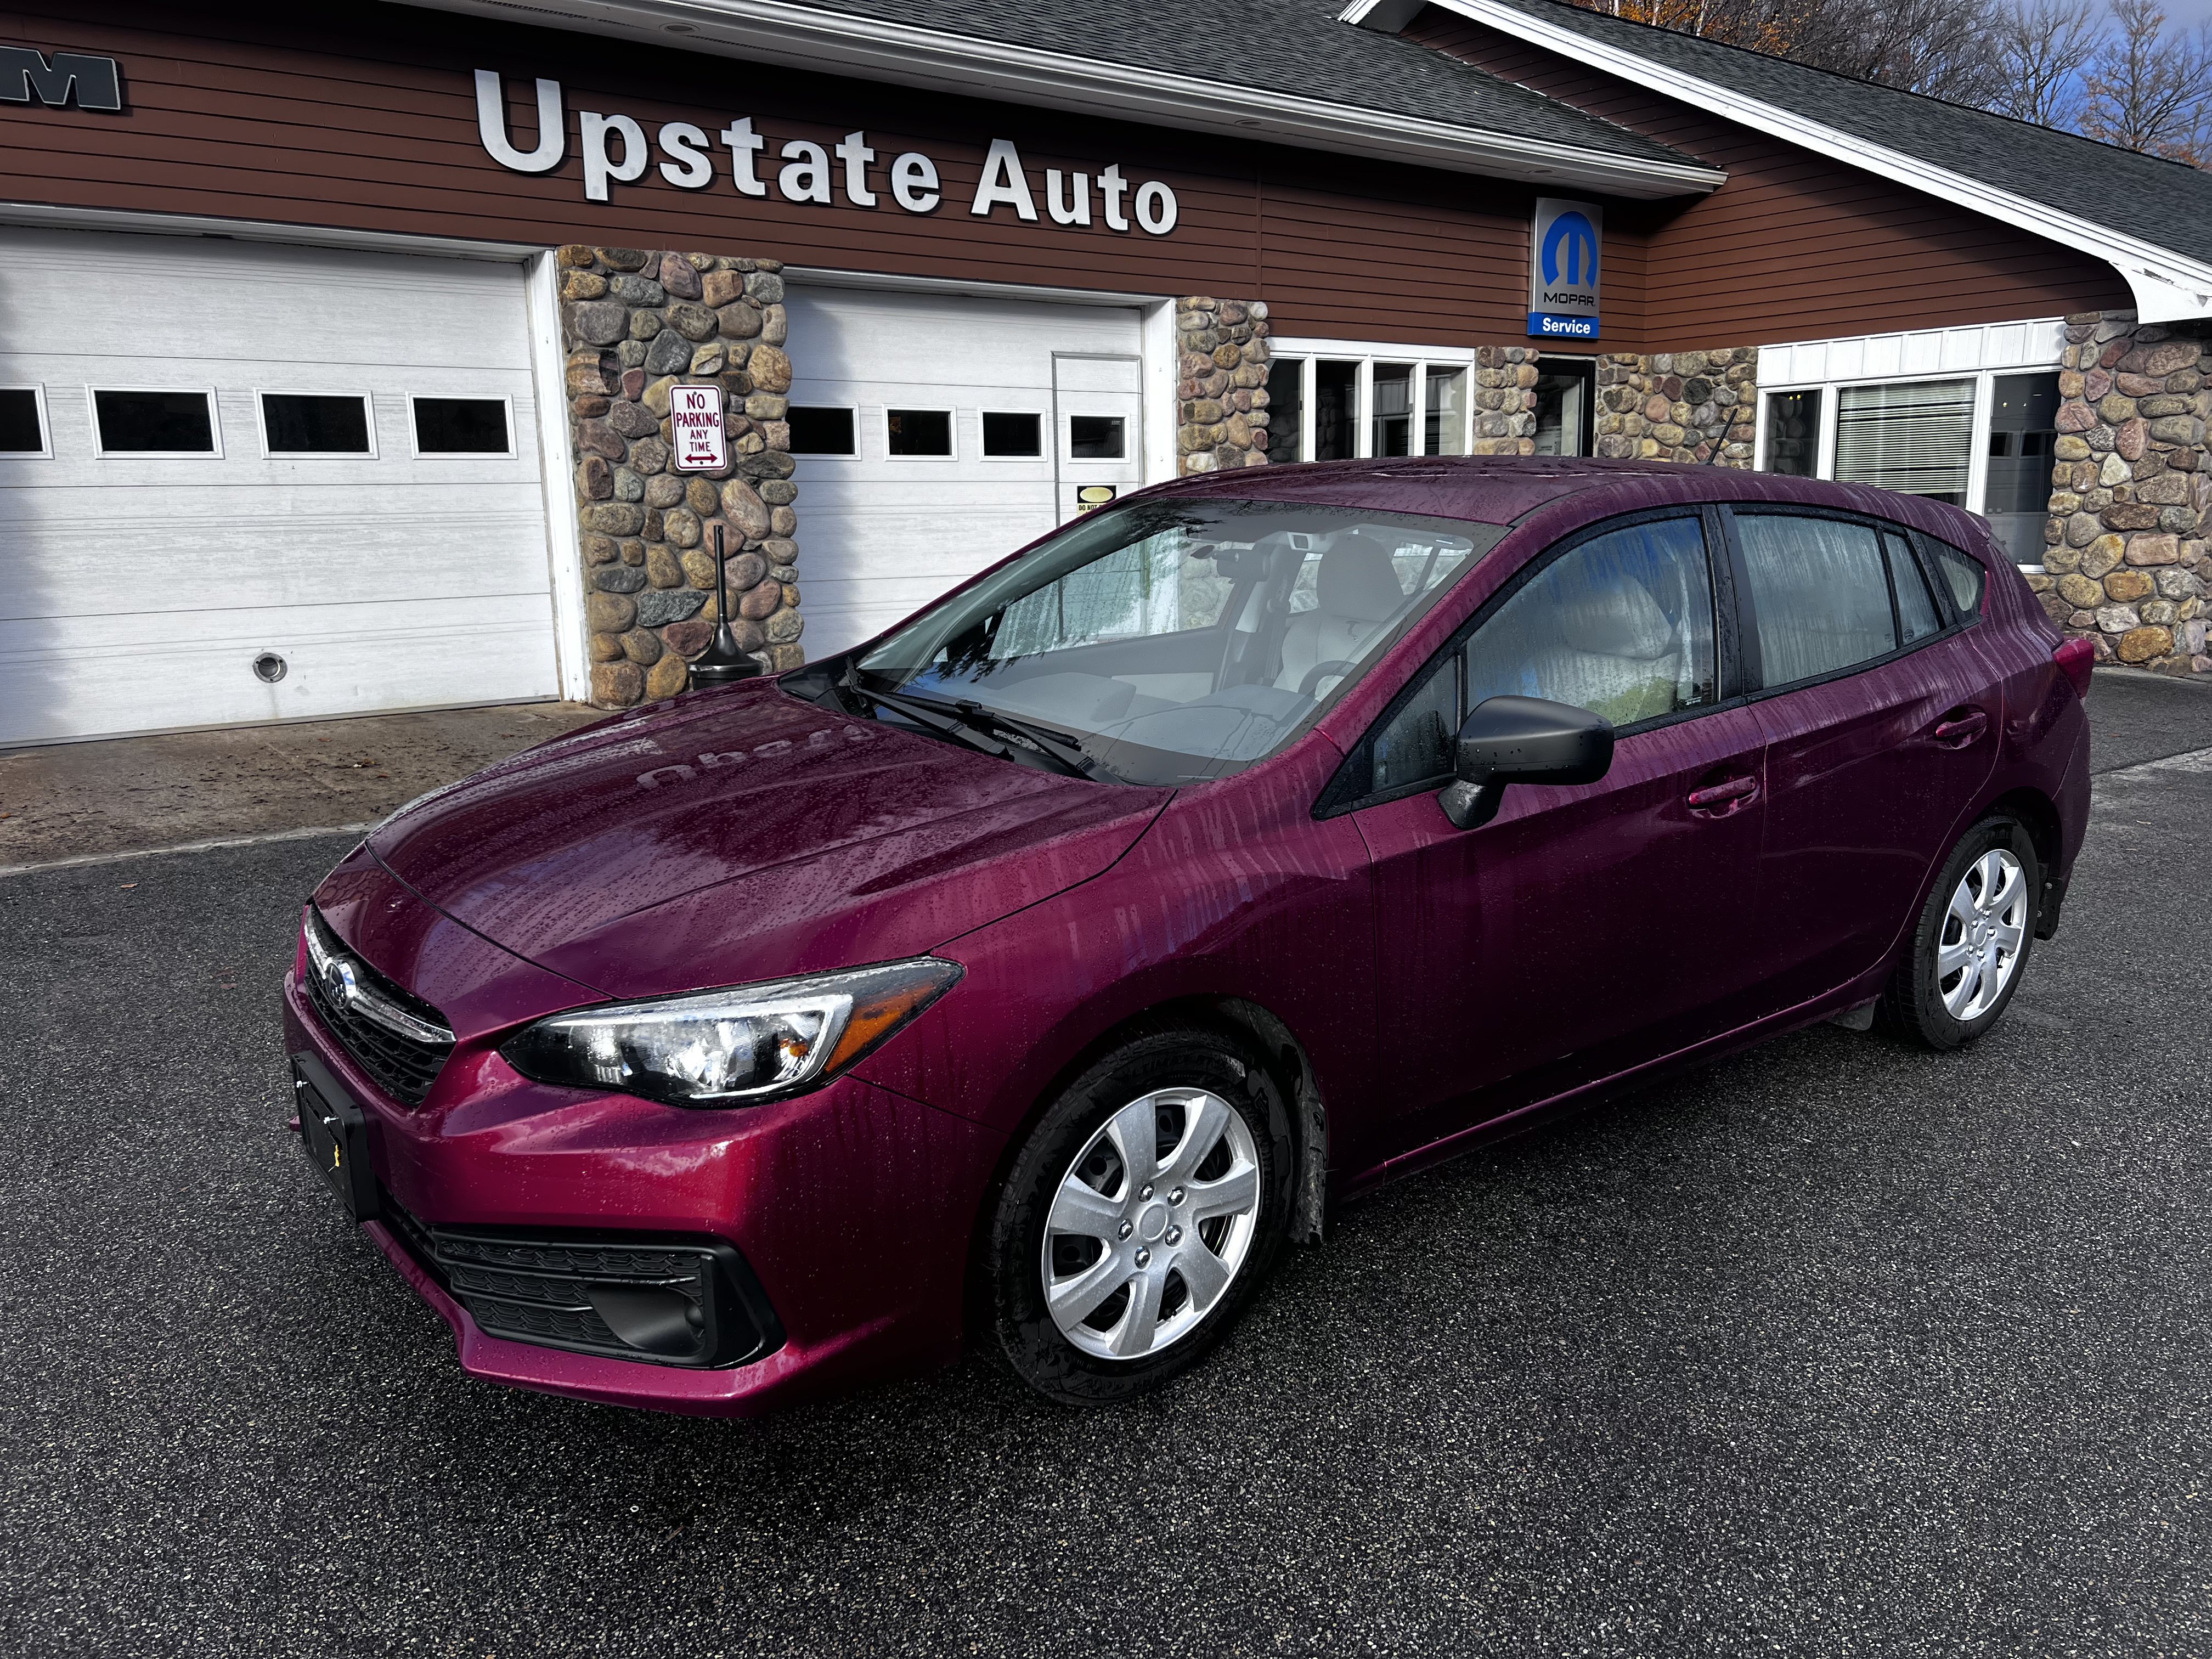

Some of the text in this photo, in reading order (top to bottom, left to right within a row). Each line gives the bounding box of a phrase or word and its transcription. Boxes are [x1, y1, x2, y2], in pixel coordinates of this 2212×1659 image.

[474, 69, 1178, 235] Upstate Auto
[1543, 292, 1594, 307] MOPAR
[1542, 317, 1591, 334] Service
[686, 393, 706, 409] NO
[676, 412, 720, 427] PARKING
[690, 429, 708, 439] ANY
[689, 441, 712, 452] TIME
